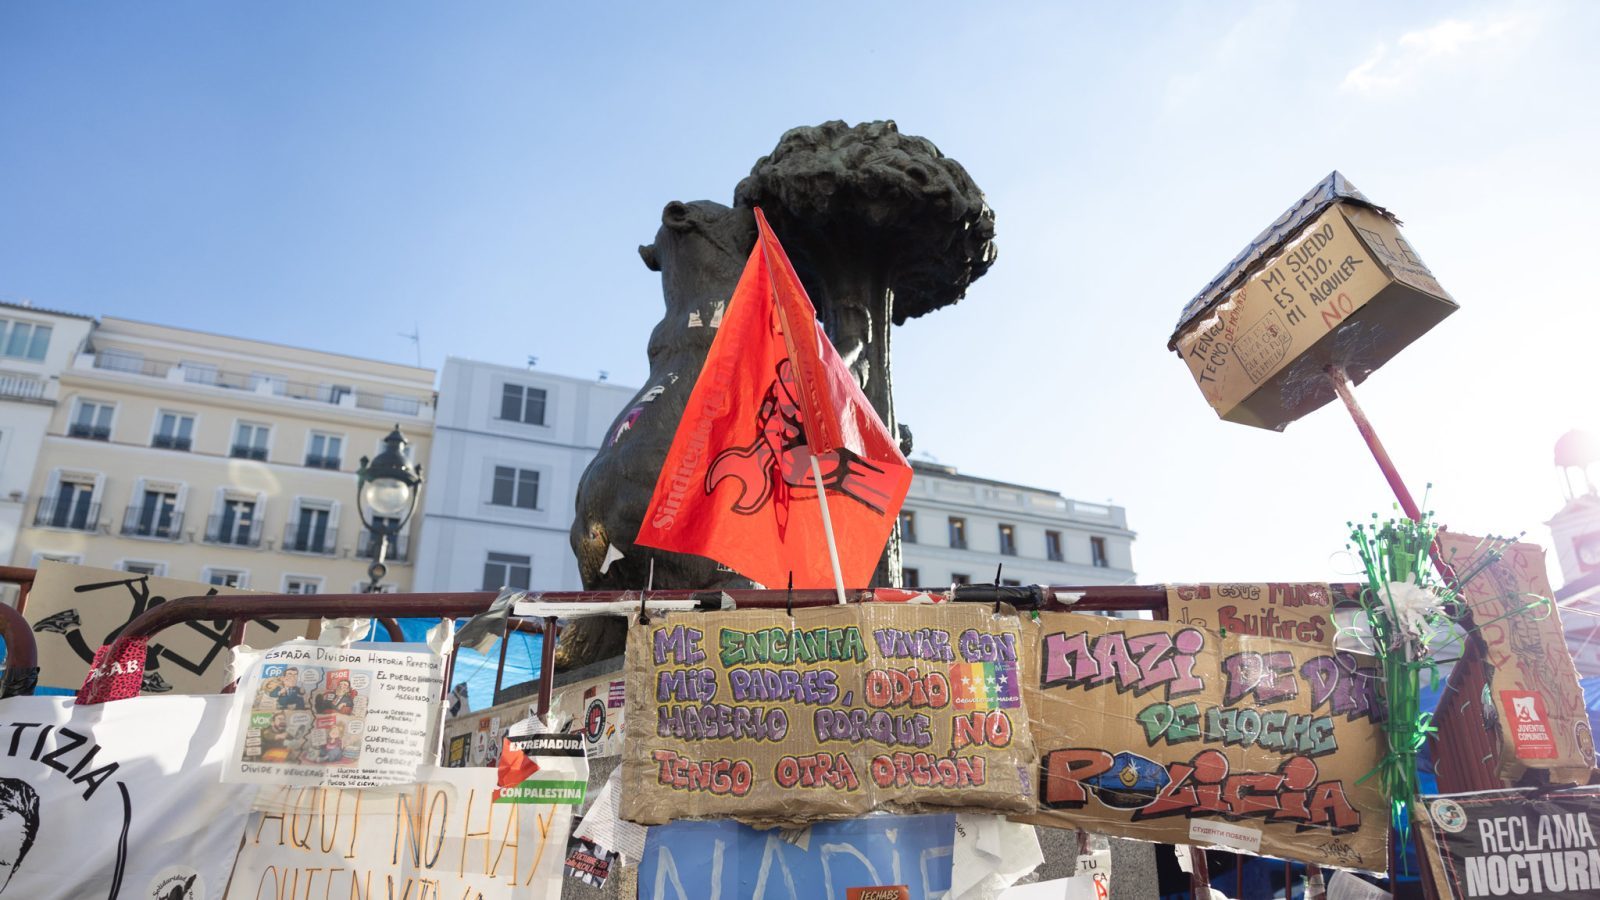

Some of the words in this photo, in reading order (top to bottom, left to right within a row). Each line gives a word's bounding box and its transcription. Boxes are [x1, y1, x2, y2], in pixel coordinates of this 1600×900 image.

[1261, 267, 1286, 292] MI
[1273, 287, 1294, 309] ES
[1286, 304, 1306, 326] MI
[1309, 255, 1364, 306] ALQUILER
[1321, 292, 1354, 330] NO
[1218, 605, 1326, 642] Buitres
[653, 625, 707, 666] ME
[718, 626, 867, 667] ENCANTA
[958, 627, 1019, 664] CON
[377, 671, 387, 680] EL
[389, 673, 417, 683] PUEBLO
[1220, 651, 1299, 707] DE
[509, 738, 586, 752] EXTREMADURA
[657, 706, 789, 743] HACERLO
[815, 706, 933, 749] PORQUE
[952, 709, 1012, 749] NO
[1136, 702, 1202, 747] DE
[1203, 704, 1338, 758] NOCHE
[0, 722, 119, 801] TIZIA
[652, 749, 753, 798] TENGO
[775, 751, 860, 792] OTRA
[500, 787, 522, 798] CON
[524, 788, 582, 799] PALESTINA
[391, 785, 448, 869] NO
[460, 788, 558, 887] HAY
[1477, 812, 1598, 854] RECLAMA
[1081, 860, 1097, 870] TU
